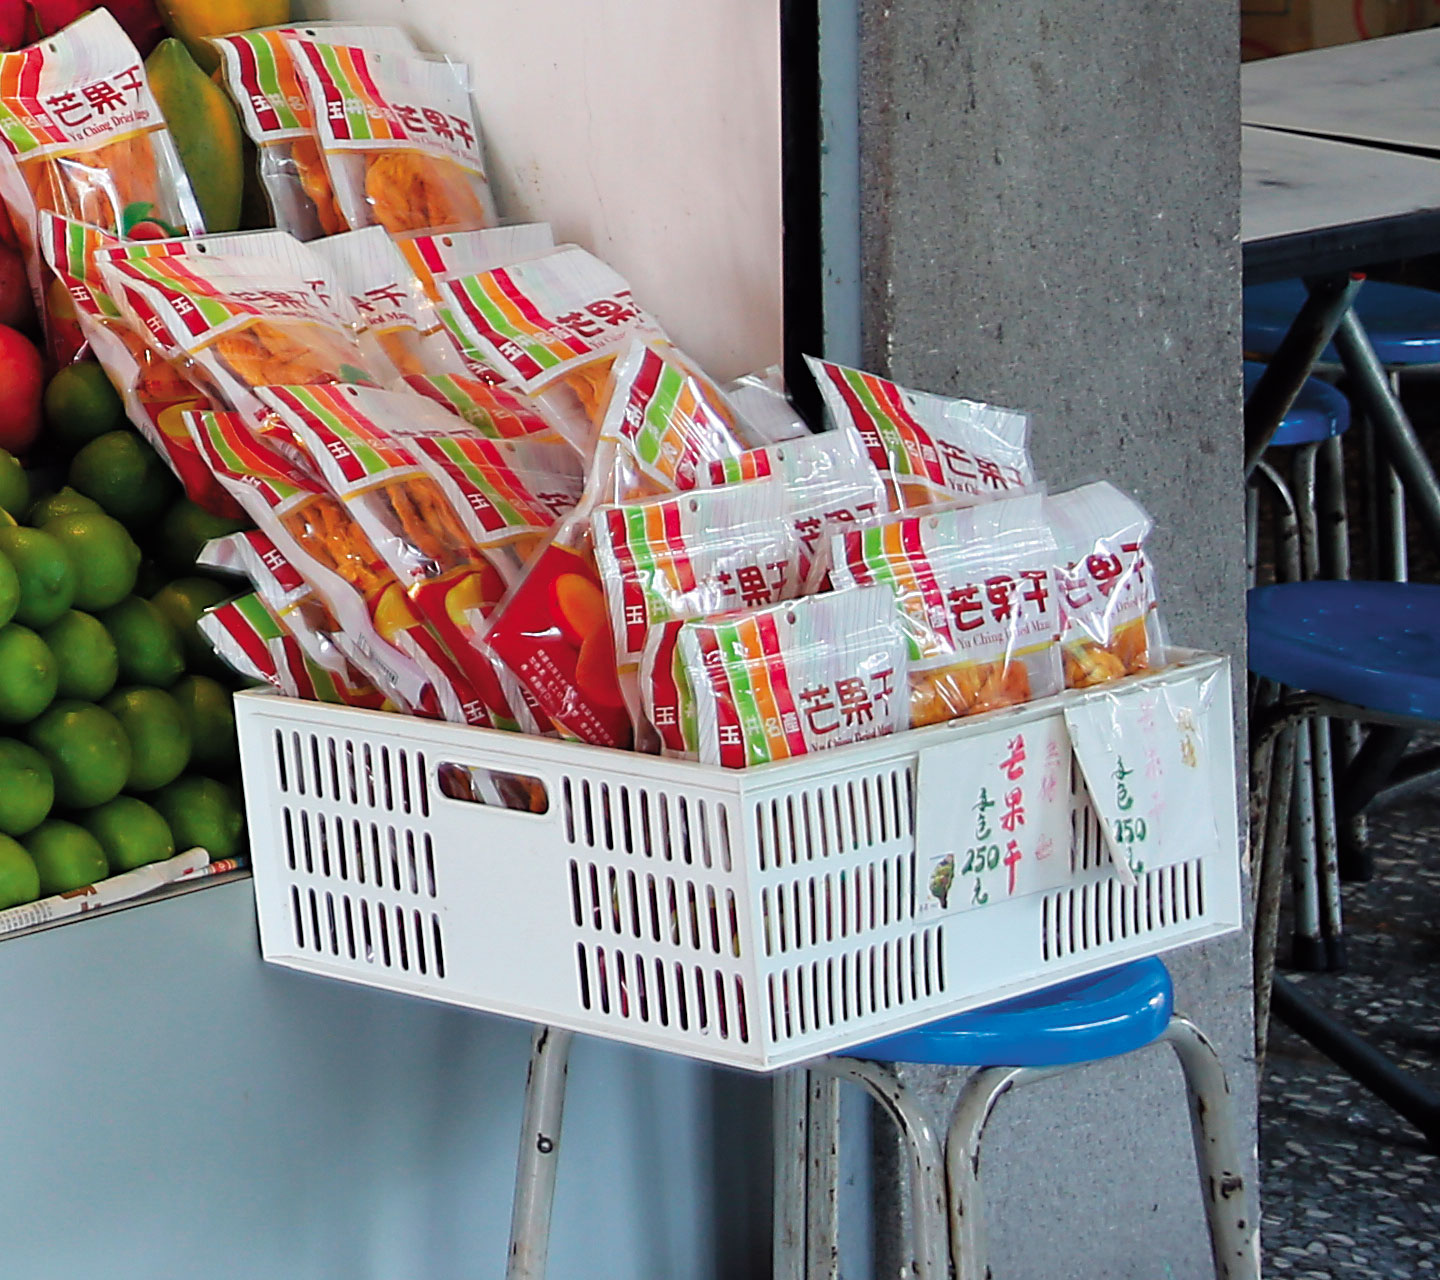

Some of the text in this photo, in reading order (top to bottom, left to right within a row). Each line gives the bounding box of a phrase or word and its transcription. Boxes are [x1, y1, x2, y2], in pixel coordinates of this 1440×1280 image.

[46, 64, 144, 128] 芒果干
[947, 570, 1049, 630] 芒果干
[798, 668, 894, 734] 芒果干
[999, 734, 1026, 896] 芒果干
